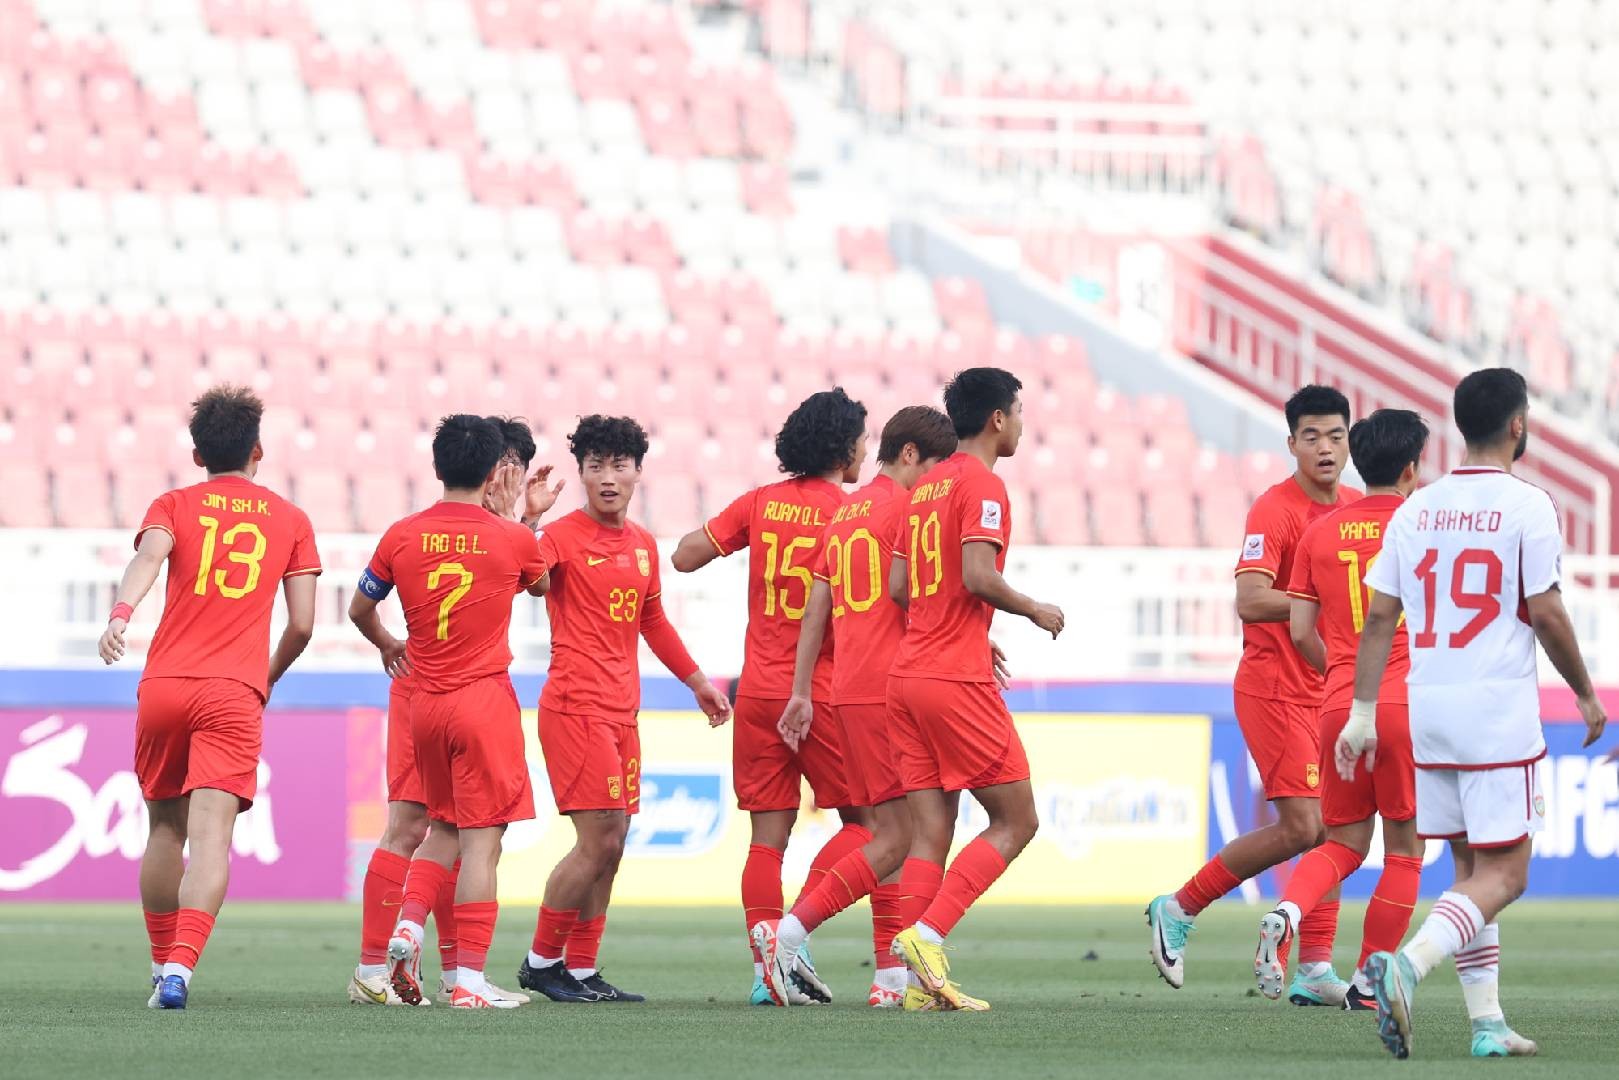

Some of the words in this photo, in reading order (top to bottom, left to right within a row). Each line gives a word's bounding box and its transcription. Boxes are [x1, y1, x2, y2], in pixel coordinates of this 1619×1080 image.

[202, 493, 227, 511] JIN
[763, 500, 801, 523] RUAN
[1339, 520, 1380, 540] YANG
[194, 515, 267, 599] 13
[421, 532, 450, 553] TAO
[909, 511, 943, 598] 19
[427, 561, 475, 641] 7
[761, 530, 817, 621] 15
[827, 527, 882, 617] 20
[1414, 548, 1503, 649] 19
[609, 587, 638, 623] 23
[625, 757, 641, 792] 2
